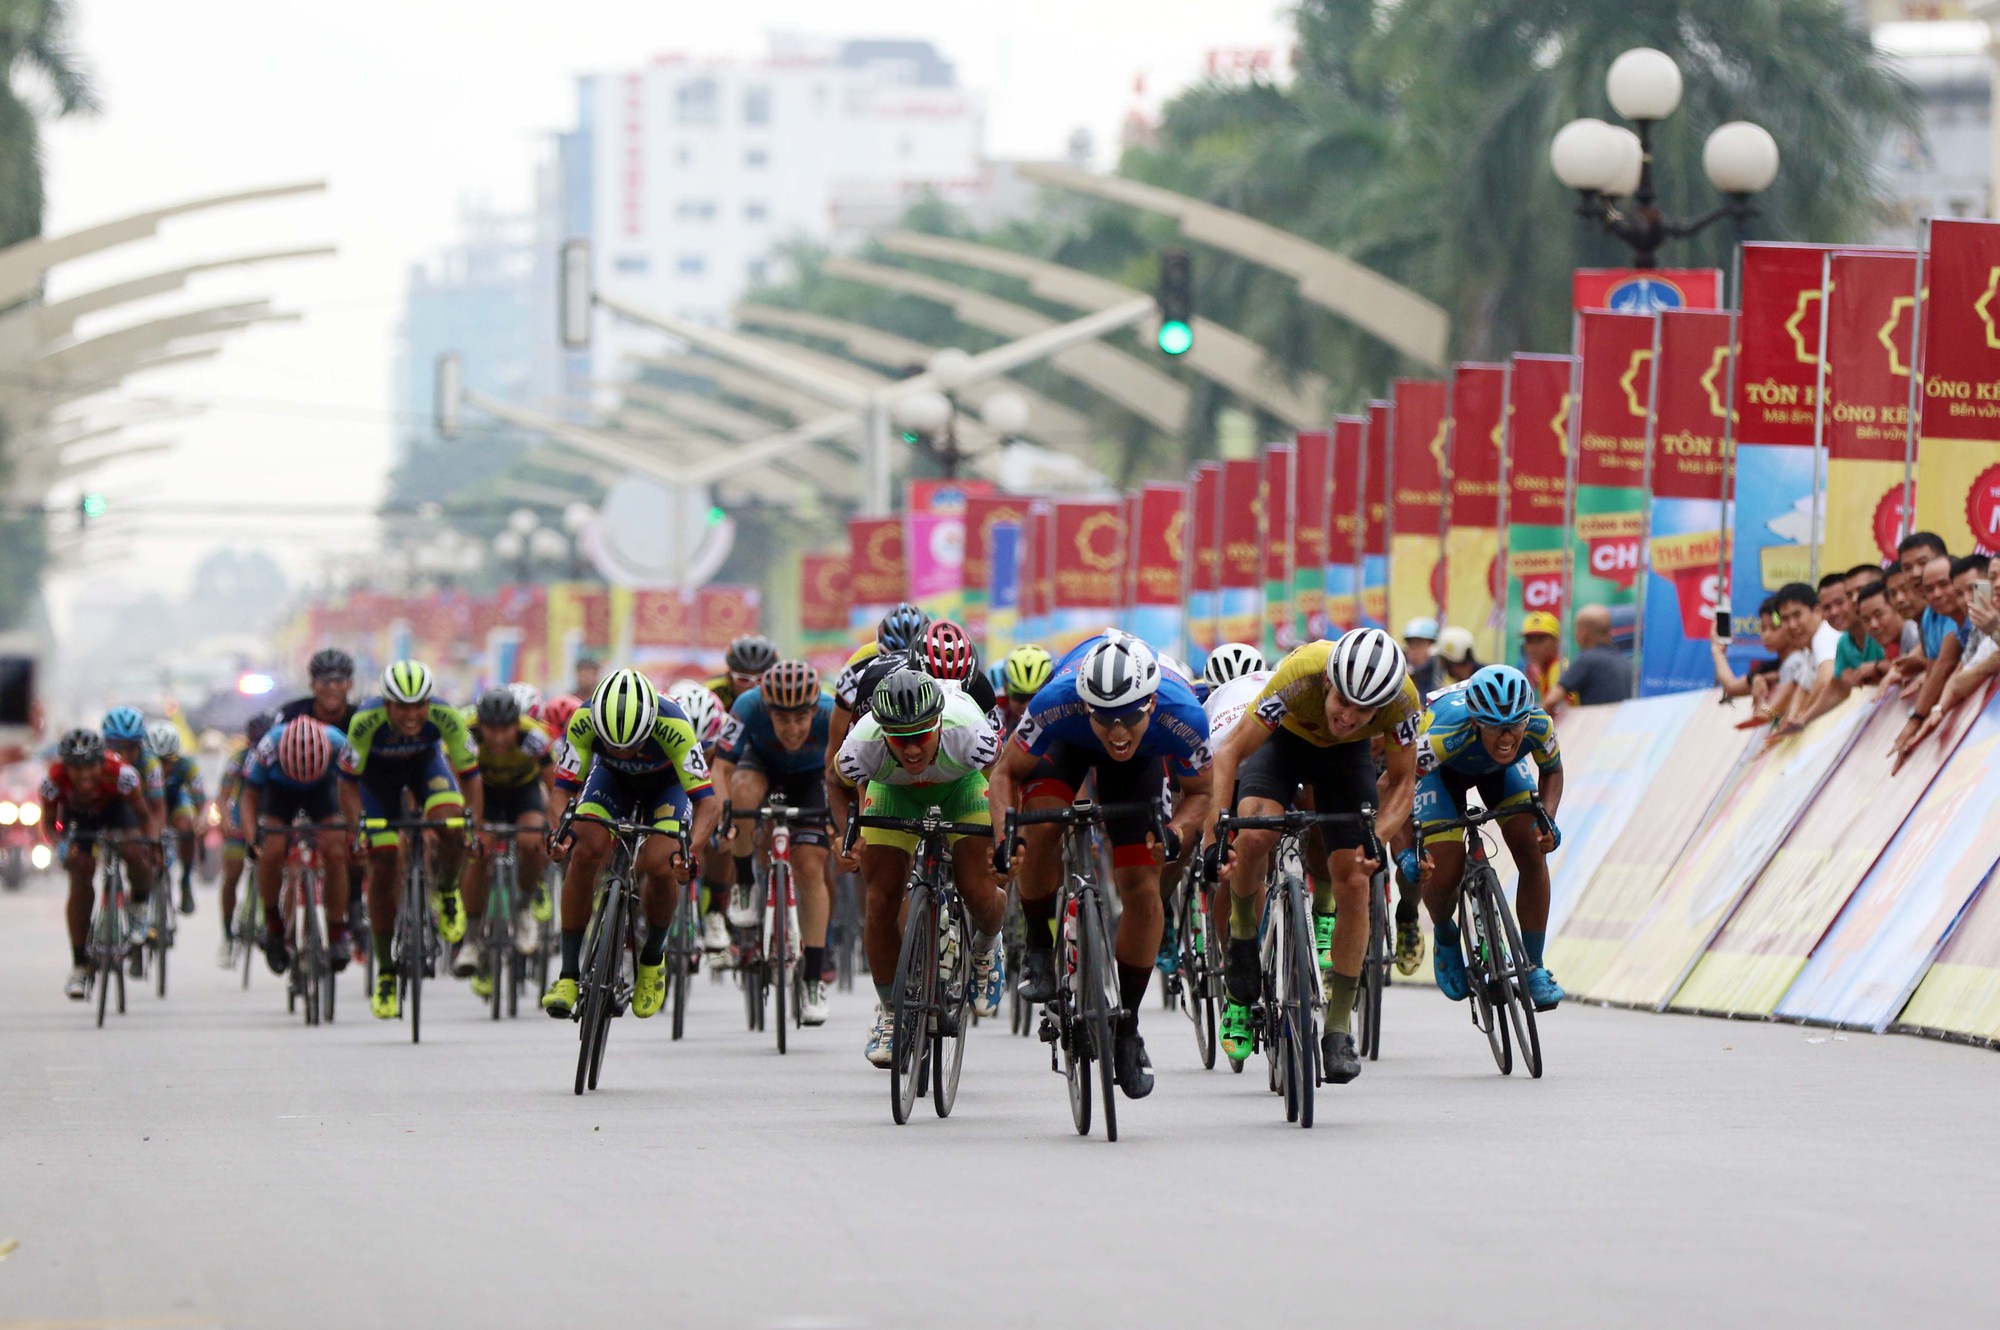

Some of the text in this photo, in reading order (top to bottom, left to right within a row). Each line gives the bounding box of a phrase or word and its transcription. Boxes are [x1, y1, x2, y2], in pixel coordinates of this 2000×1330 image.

[1745, 376, 1798, 405] TÔN
[1661, 428, 1713, 457] TÔN
[653, 719, 686, 749] NAVY
[1018, 718, 1036, 741] 2
[971, 734, 998, 765] 114
[1196, 746, 1212, 765] 2
[839, 755, 868, 783] 114
